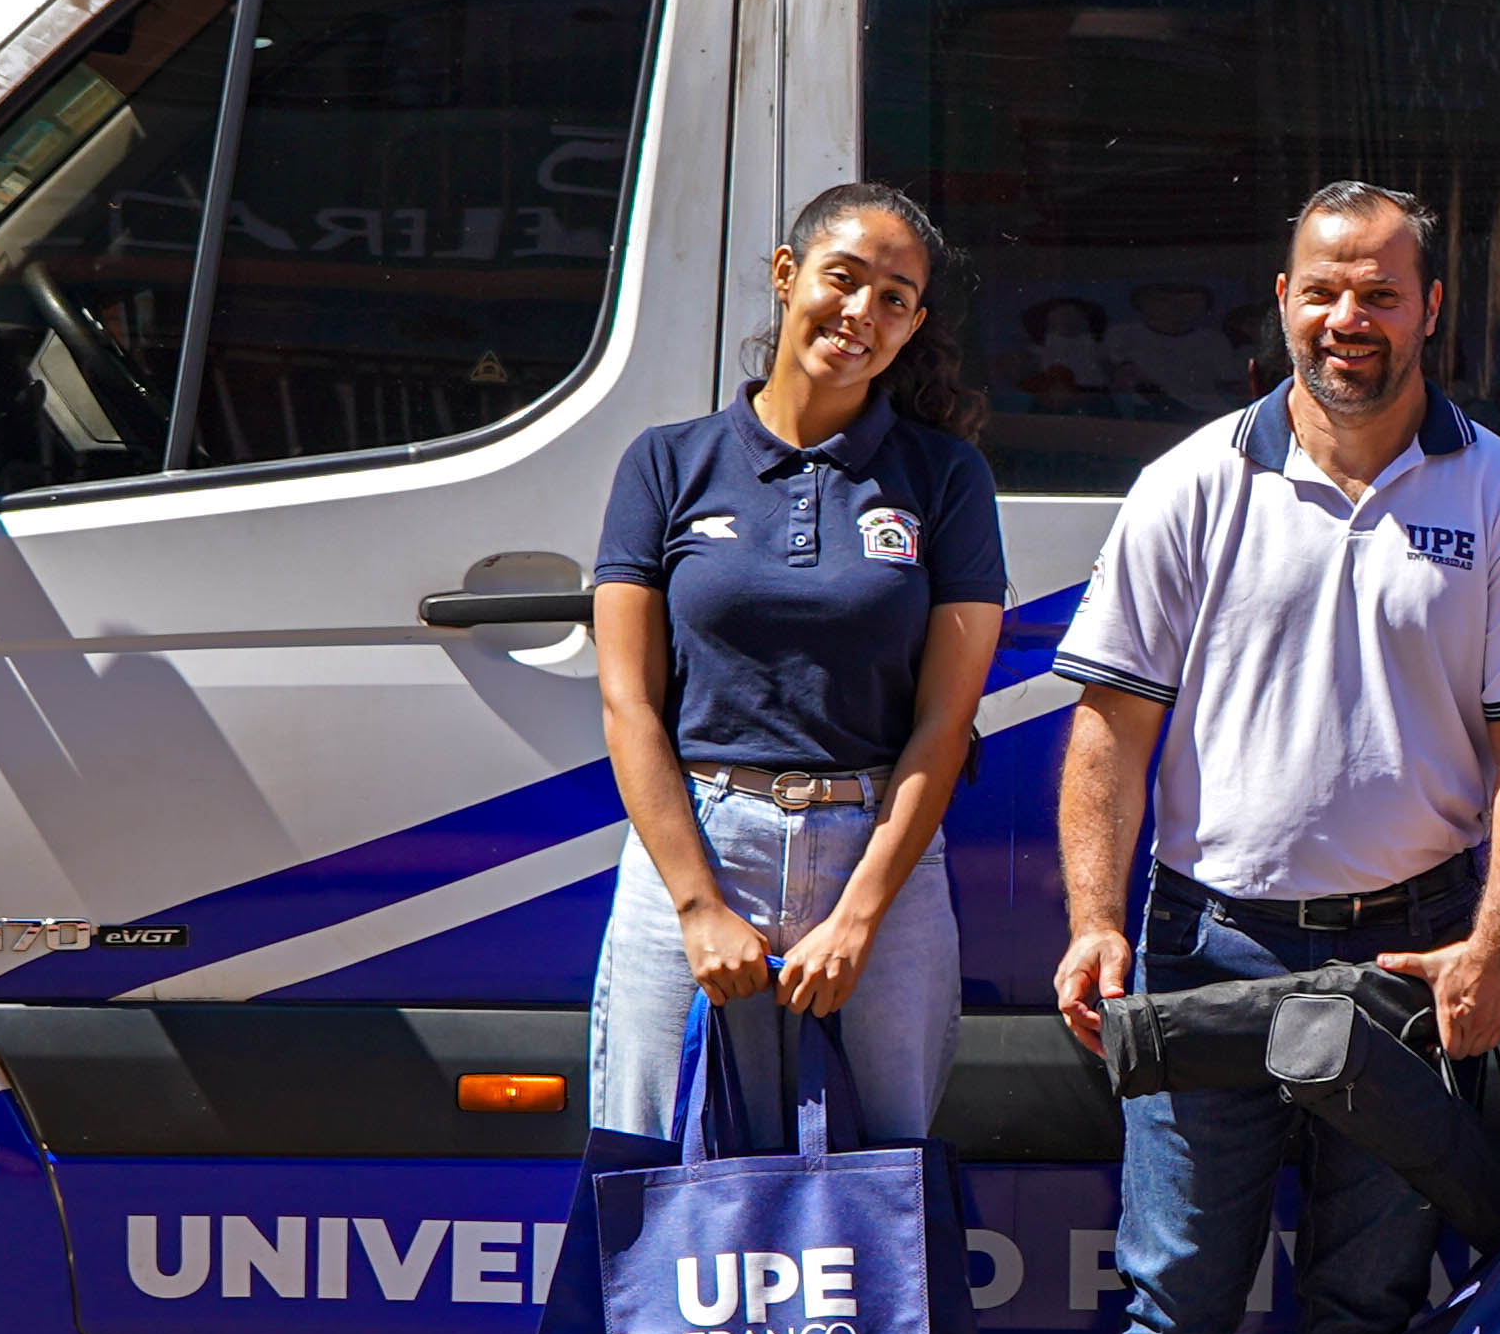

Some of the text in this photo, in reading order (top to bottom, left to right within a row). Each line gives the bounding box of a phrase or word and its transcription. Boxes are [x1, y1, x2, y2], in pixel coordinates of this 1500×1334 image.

[1406, 523, 1476, 561] UPE
[1406, 551, 1474, 571] UNIVERSIDAD
[105, 928, 181, 944] eVGT
[676, 1246, 858, 1327] UPE
